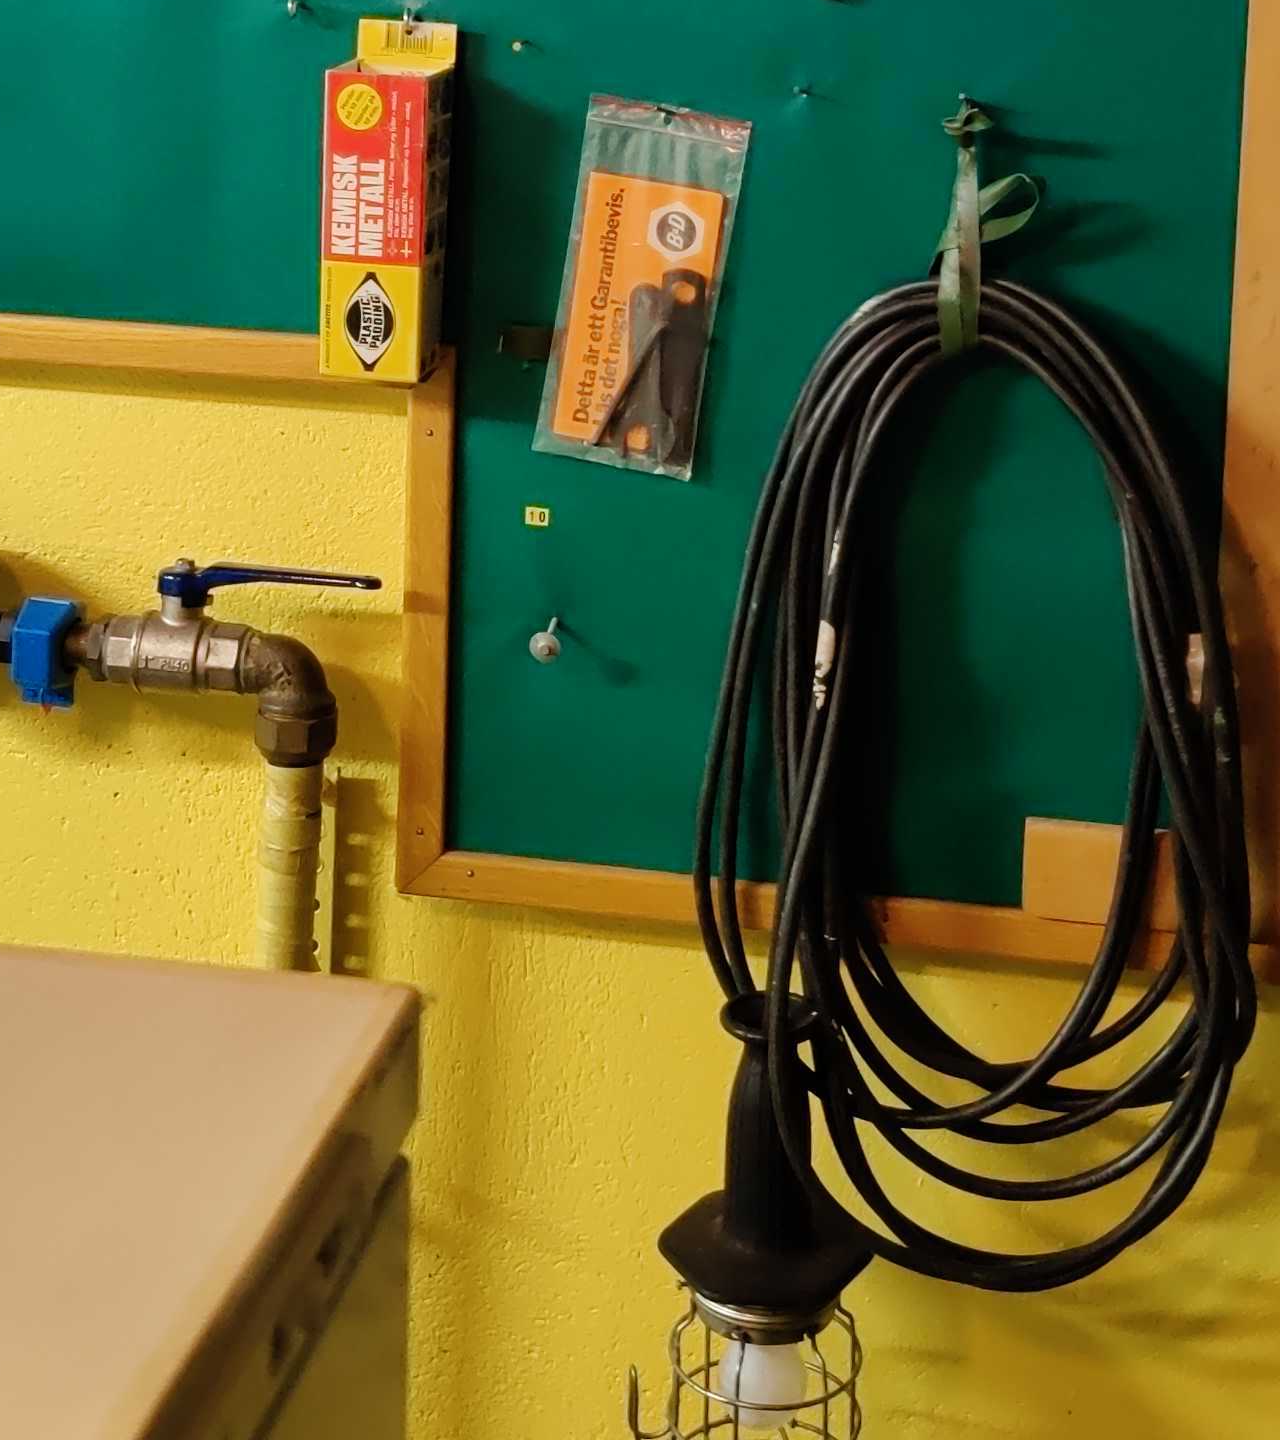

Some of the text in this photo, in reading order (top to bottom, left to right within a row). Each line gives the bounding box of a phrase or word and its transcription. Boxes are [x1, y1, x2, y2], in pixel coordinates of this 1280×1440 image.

[330, 152, 359, 256] KEMISK
[357, 158, 385, 257] METALL
[359, 297, 373, 345] PLASTIC
[369, 295, 384, 349] PADDING
[572, 188, 626, 424] Detta är ett Garantibevis.
[607, 297, 628, 354] noga!
[599, 358, 619, 392] det
[529, 511, 545, 523] 10
